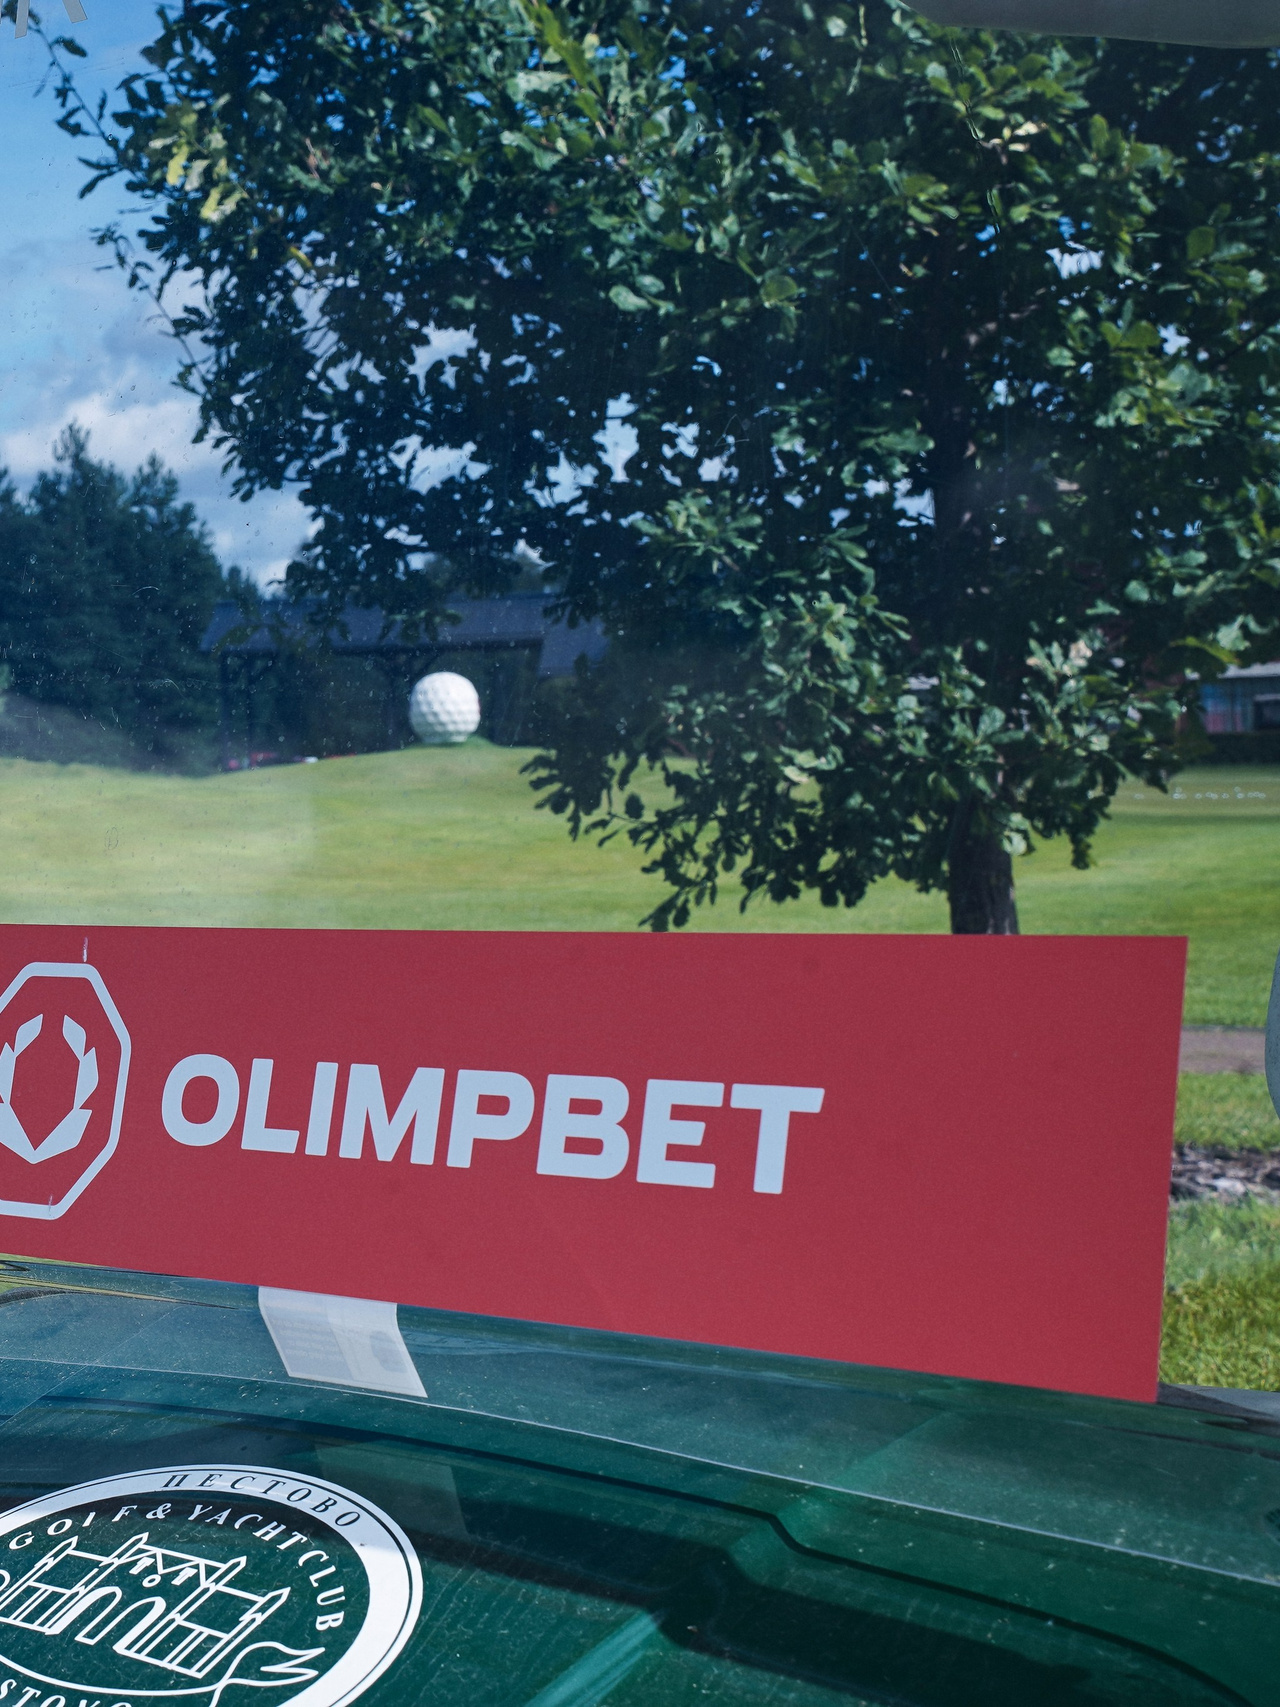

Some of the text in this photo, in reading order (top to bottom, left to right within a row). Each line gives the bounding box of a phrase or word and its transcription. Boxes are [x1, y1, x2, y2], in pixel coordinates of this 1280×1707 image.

[161, 1053, 825, 1194] OLIMPBET
[160, 1473, 361, 1527] ПЕСТОВО
[145, 1502, 172, 1520] &
[188, 1504, 308, 1551] YACHT
[298, 1549, 346, 1631] CLUB
